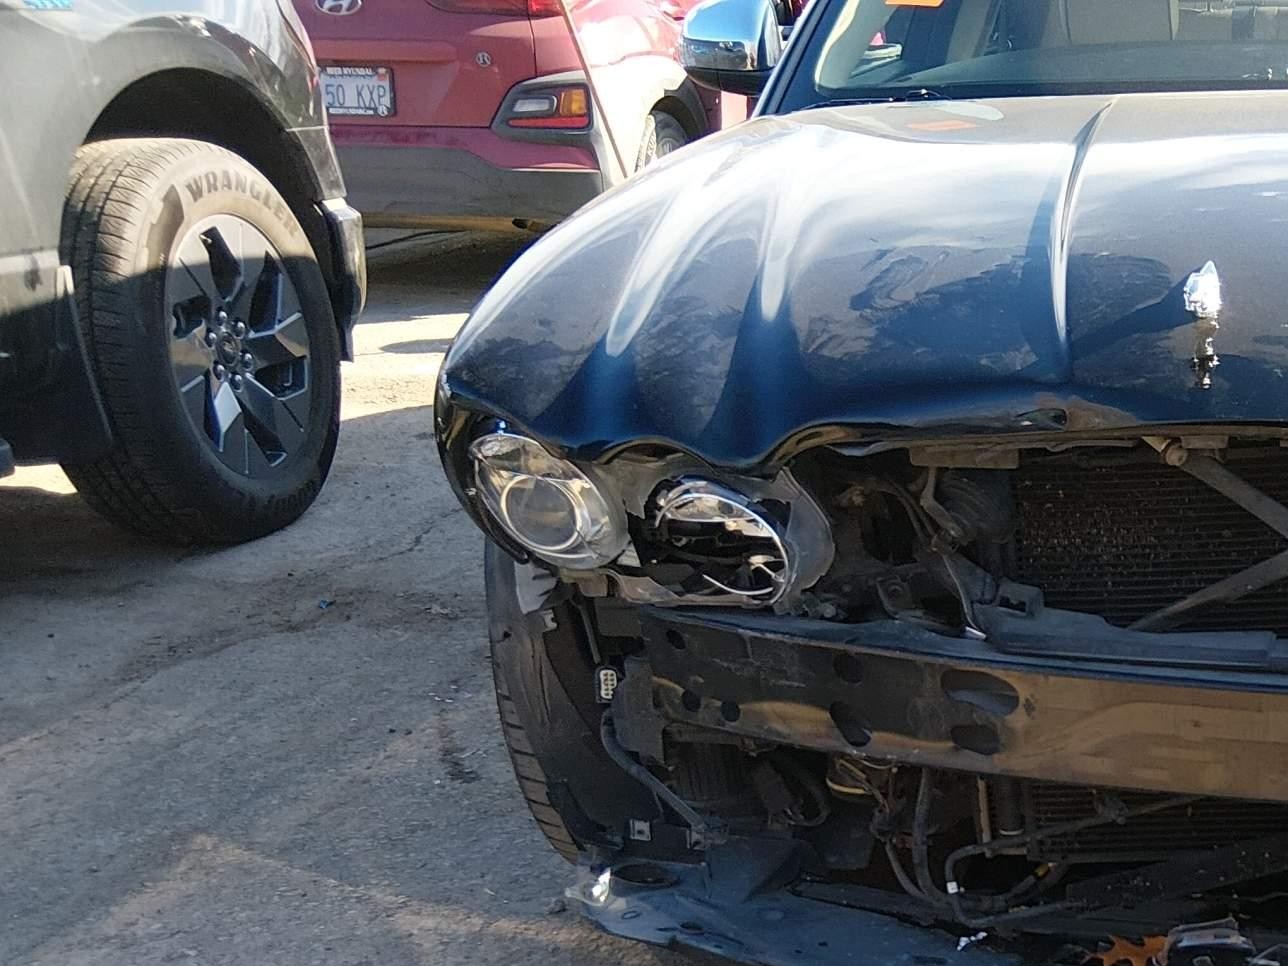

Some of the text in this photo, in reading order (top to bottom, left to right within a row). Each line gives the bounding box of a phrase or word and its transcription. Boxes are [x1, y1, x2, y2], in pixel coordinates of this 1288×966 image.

[325, 84, 387, 109] 50 KXP
[185, 170, 298, 236] WRANGLER
